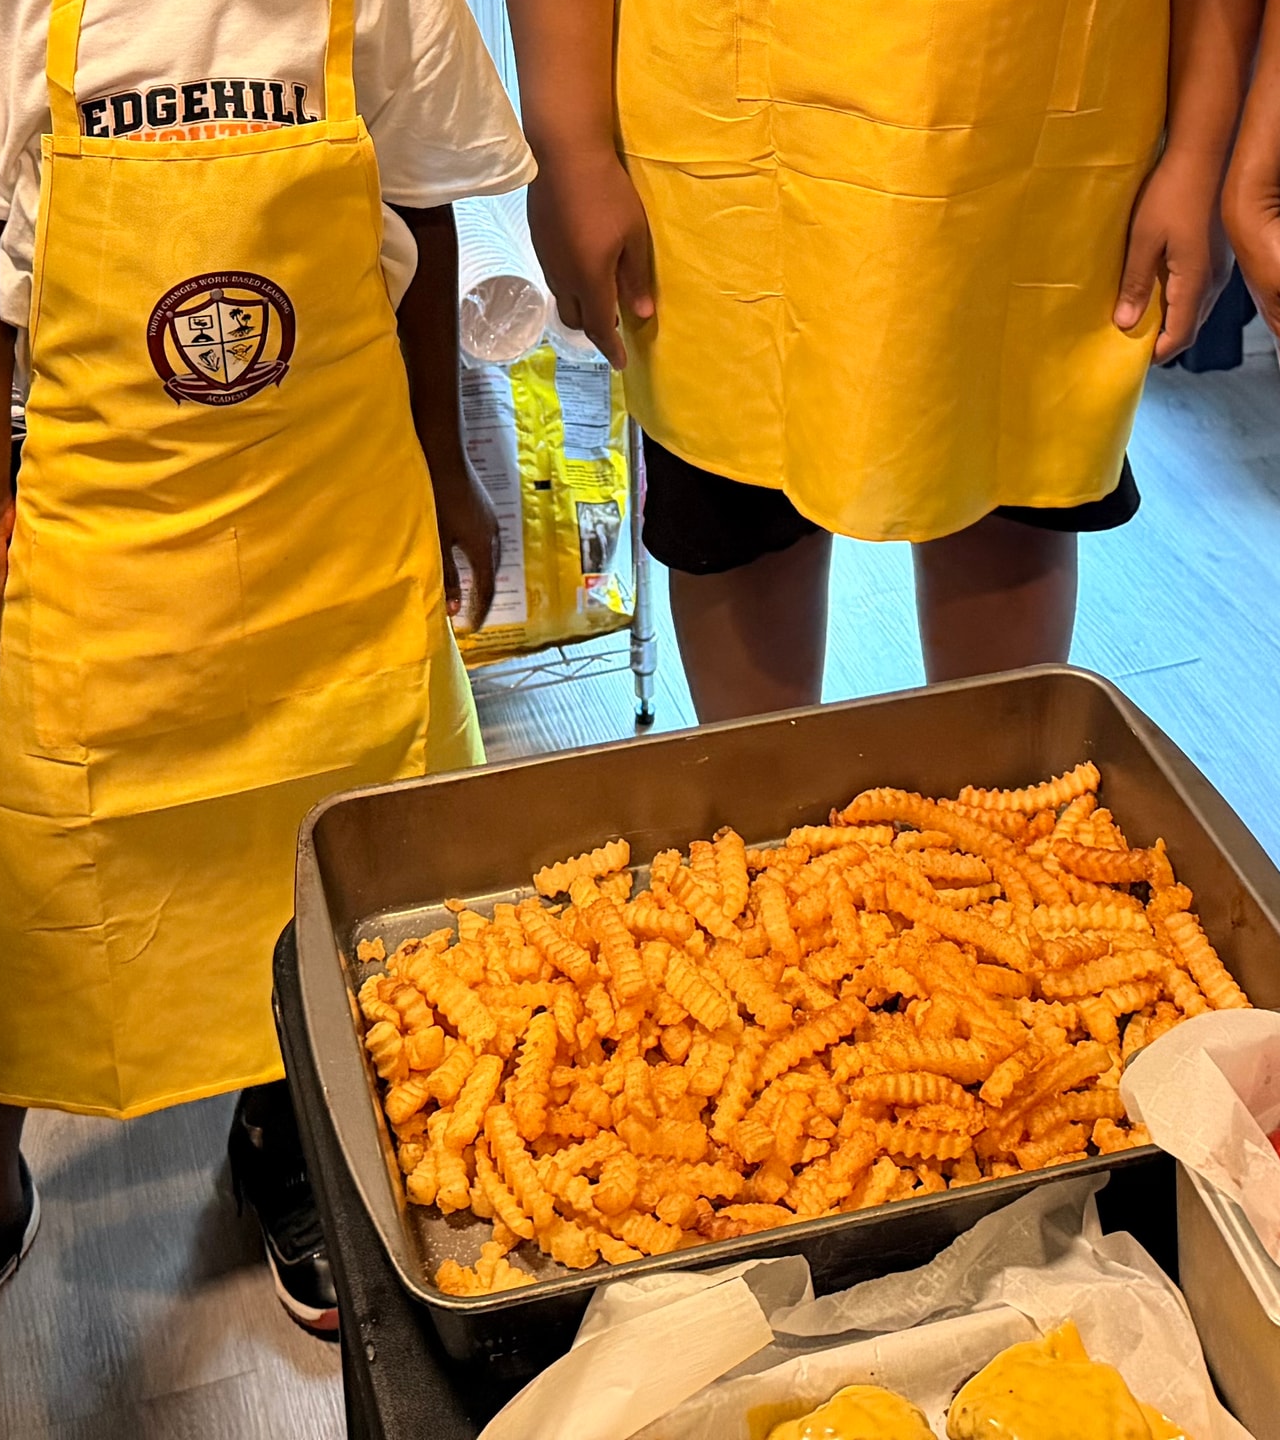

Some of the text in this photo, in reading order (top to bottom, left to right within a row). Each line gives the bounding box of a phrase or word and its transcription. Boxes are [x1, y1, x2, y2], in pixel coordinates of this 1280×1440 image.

[81, 80, 319, 138] EDGEHILL
[149, 308, 164, 337] YOUTH
[161, 281, 198, 311] CHANGES
[261, 283, 290, 315] LEARNING
[206, 390, 249, 404] ACADEMY
